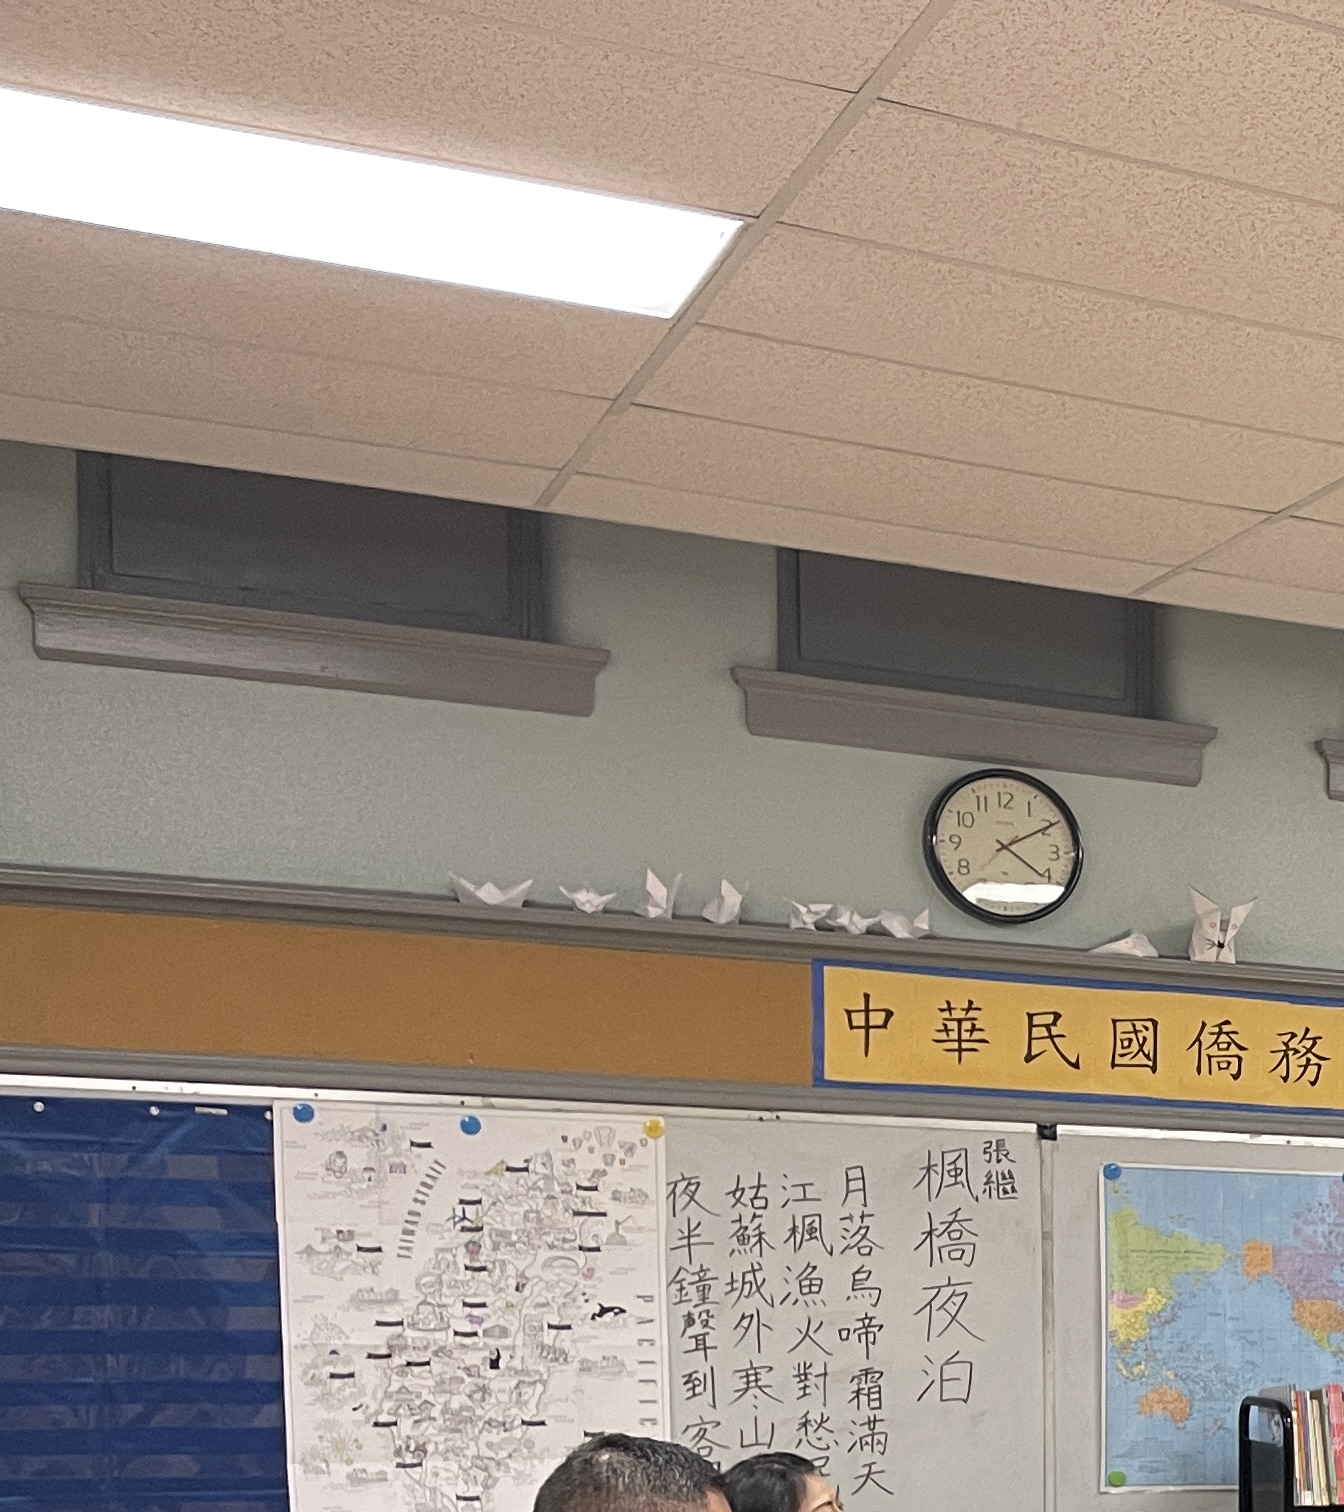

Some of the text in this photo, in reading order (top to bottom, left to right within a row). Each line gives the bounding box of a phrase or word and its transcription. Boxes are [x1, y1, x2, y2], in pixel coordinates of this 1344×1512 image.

[976, 795, 988, 813] 11
[997, 791, 1014, 810] 12
[957, 811, 975, 828] 10
[1041, 819, 1052, 836] 2
[949, 834, 962, 850] 9
[1049, 844, 1060, 861] 3
[957, 858, 970, 875] 8
[983, 1139, 1018, 1201] 張繼
[912, 1147, 985, 1405] 楓橋夜泊
[666, 1172, 730, 1474] 夜半鐘聲到客
